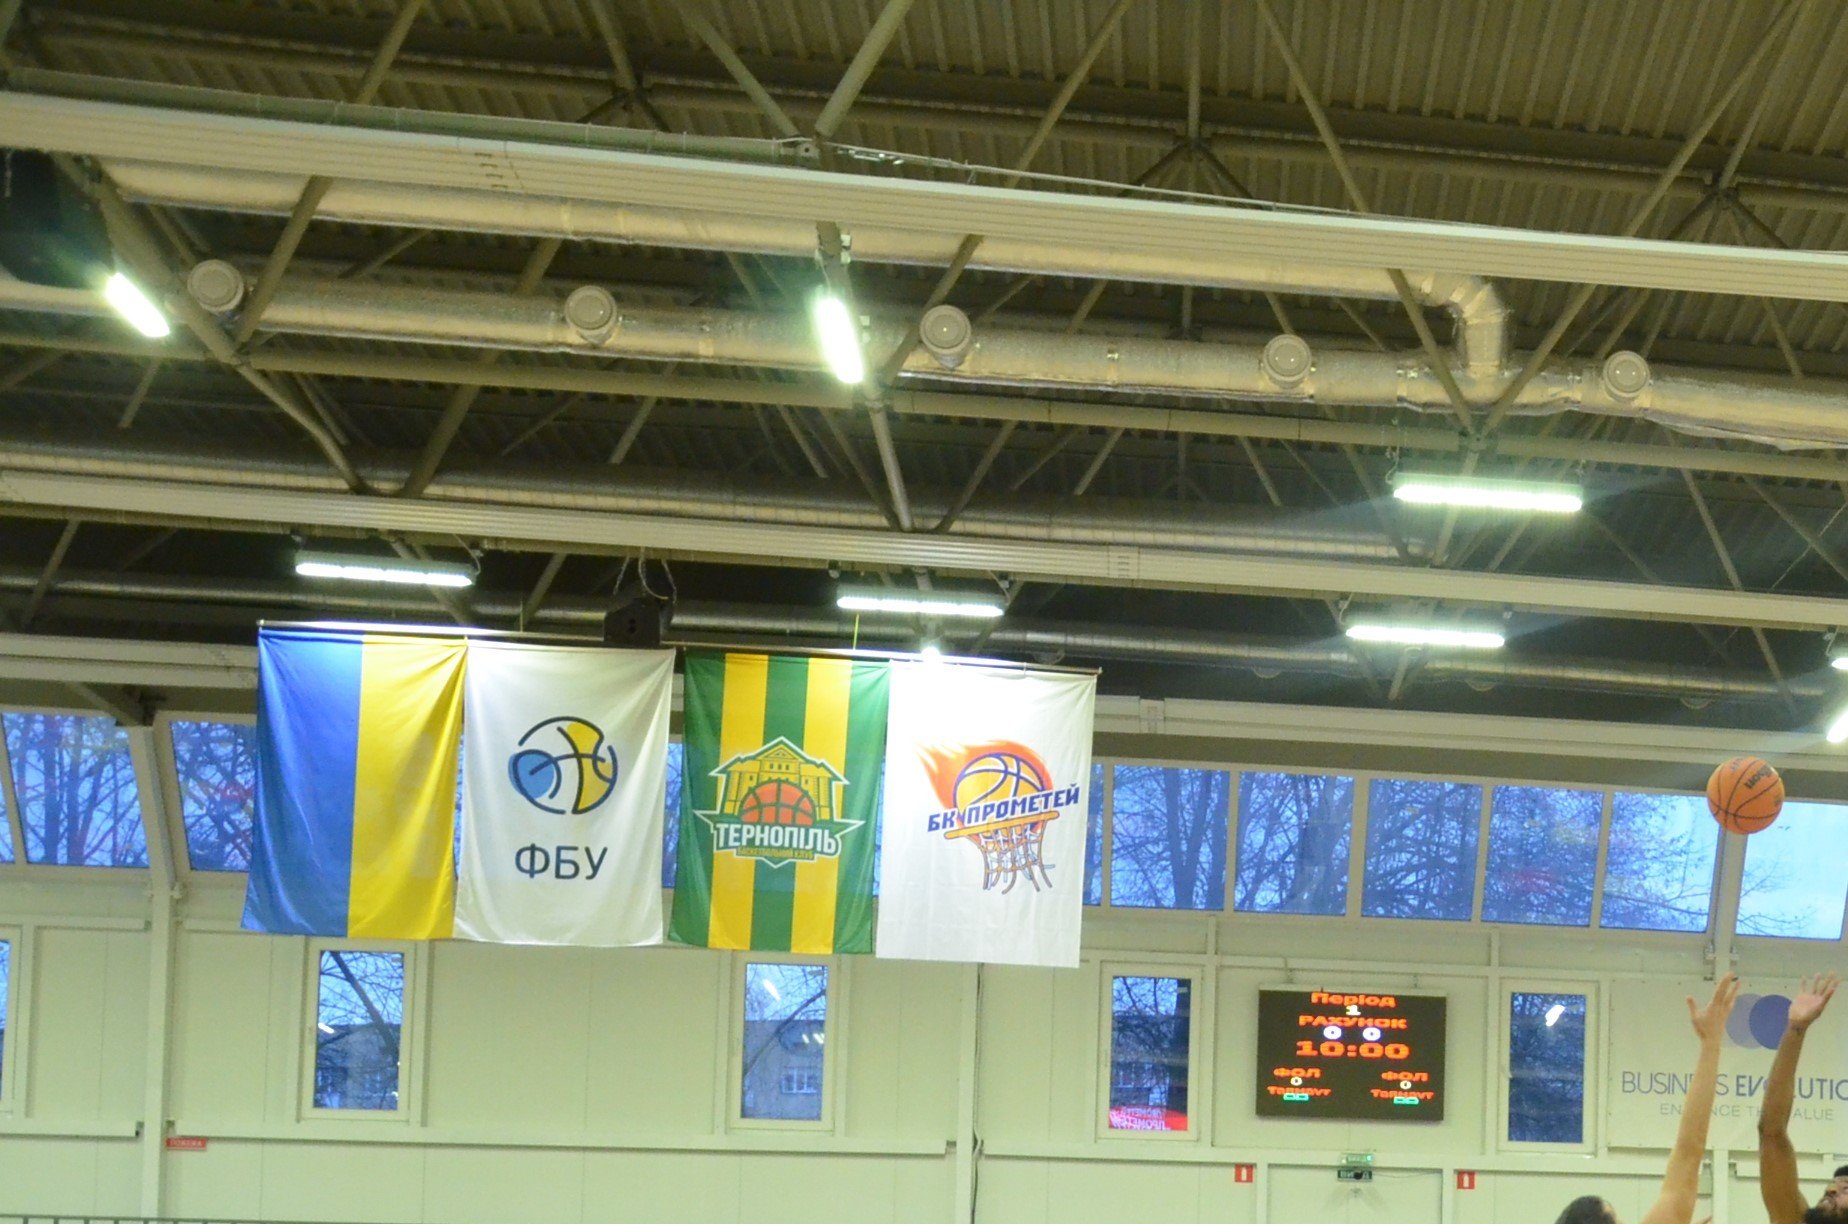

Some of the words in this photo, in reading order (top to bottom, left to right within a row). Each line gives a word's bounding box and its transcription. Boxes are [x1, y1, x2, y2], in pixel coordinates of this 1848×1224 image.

[927, 808, 956, 832] БК
[966, 783, 1080, 824] ПРОМЕТЕЙ
[716, 823, 837, 854] ТЕРНОПІЛЬ
[515, 843, 608, 880] ФБУ
[1311, 992, 1396, 1008] Період
[1346, 1004, 1361, 1016] 1
[1299, 1016, 1408, 1029] РАХУНОК
[1323, 1025, 1342, 1040] 0
[1362, 1026, 1381, 1042] 0
[1296, 1041, 1410, 1059] 10:00
[1273, 1067, 1321, 1078] ФОЛ
[1381, 1071, 1428, 1082] ФОЛ
[1290, 1076, 1303, 1086] 0
[1621, 1071, 1729, 1096] BUSINS
[1793, 1107, 1834, 1120] ALUE
